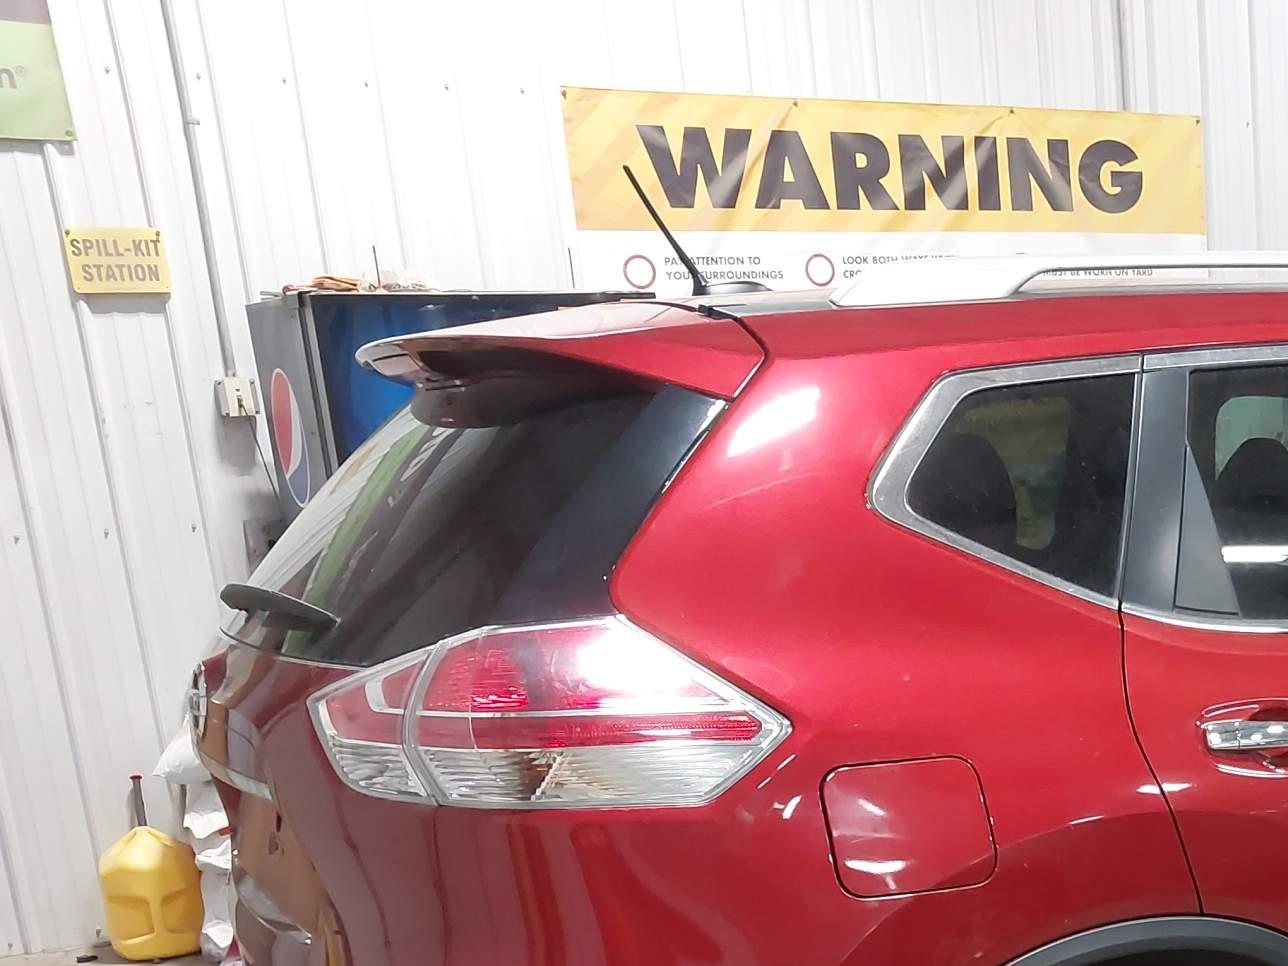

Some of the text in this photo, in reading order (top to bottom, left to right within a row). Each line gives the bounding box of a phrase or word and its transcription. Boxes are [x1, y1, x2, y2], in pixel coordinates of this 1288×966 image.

[635, 124, 1143, 213] WARNING
[70, 239, 160, 256] SPILL-KIT
[748, 256, 760, 265] TO
[842, 256, 869, 265] LOOK
[82, 264, 160, 282] STATION
[665, 271, 691, 280] YOU
